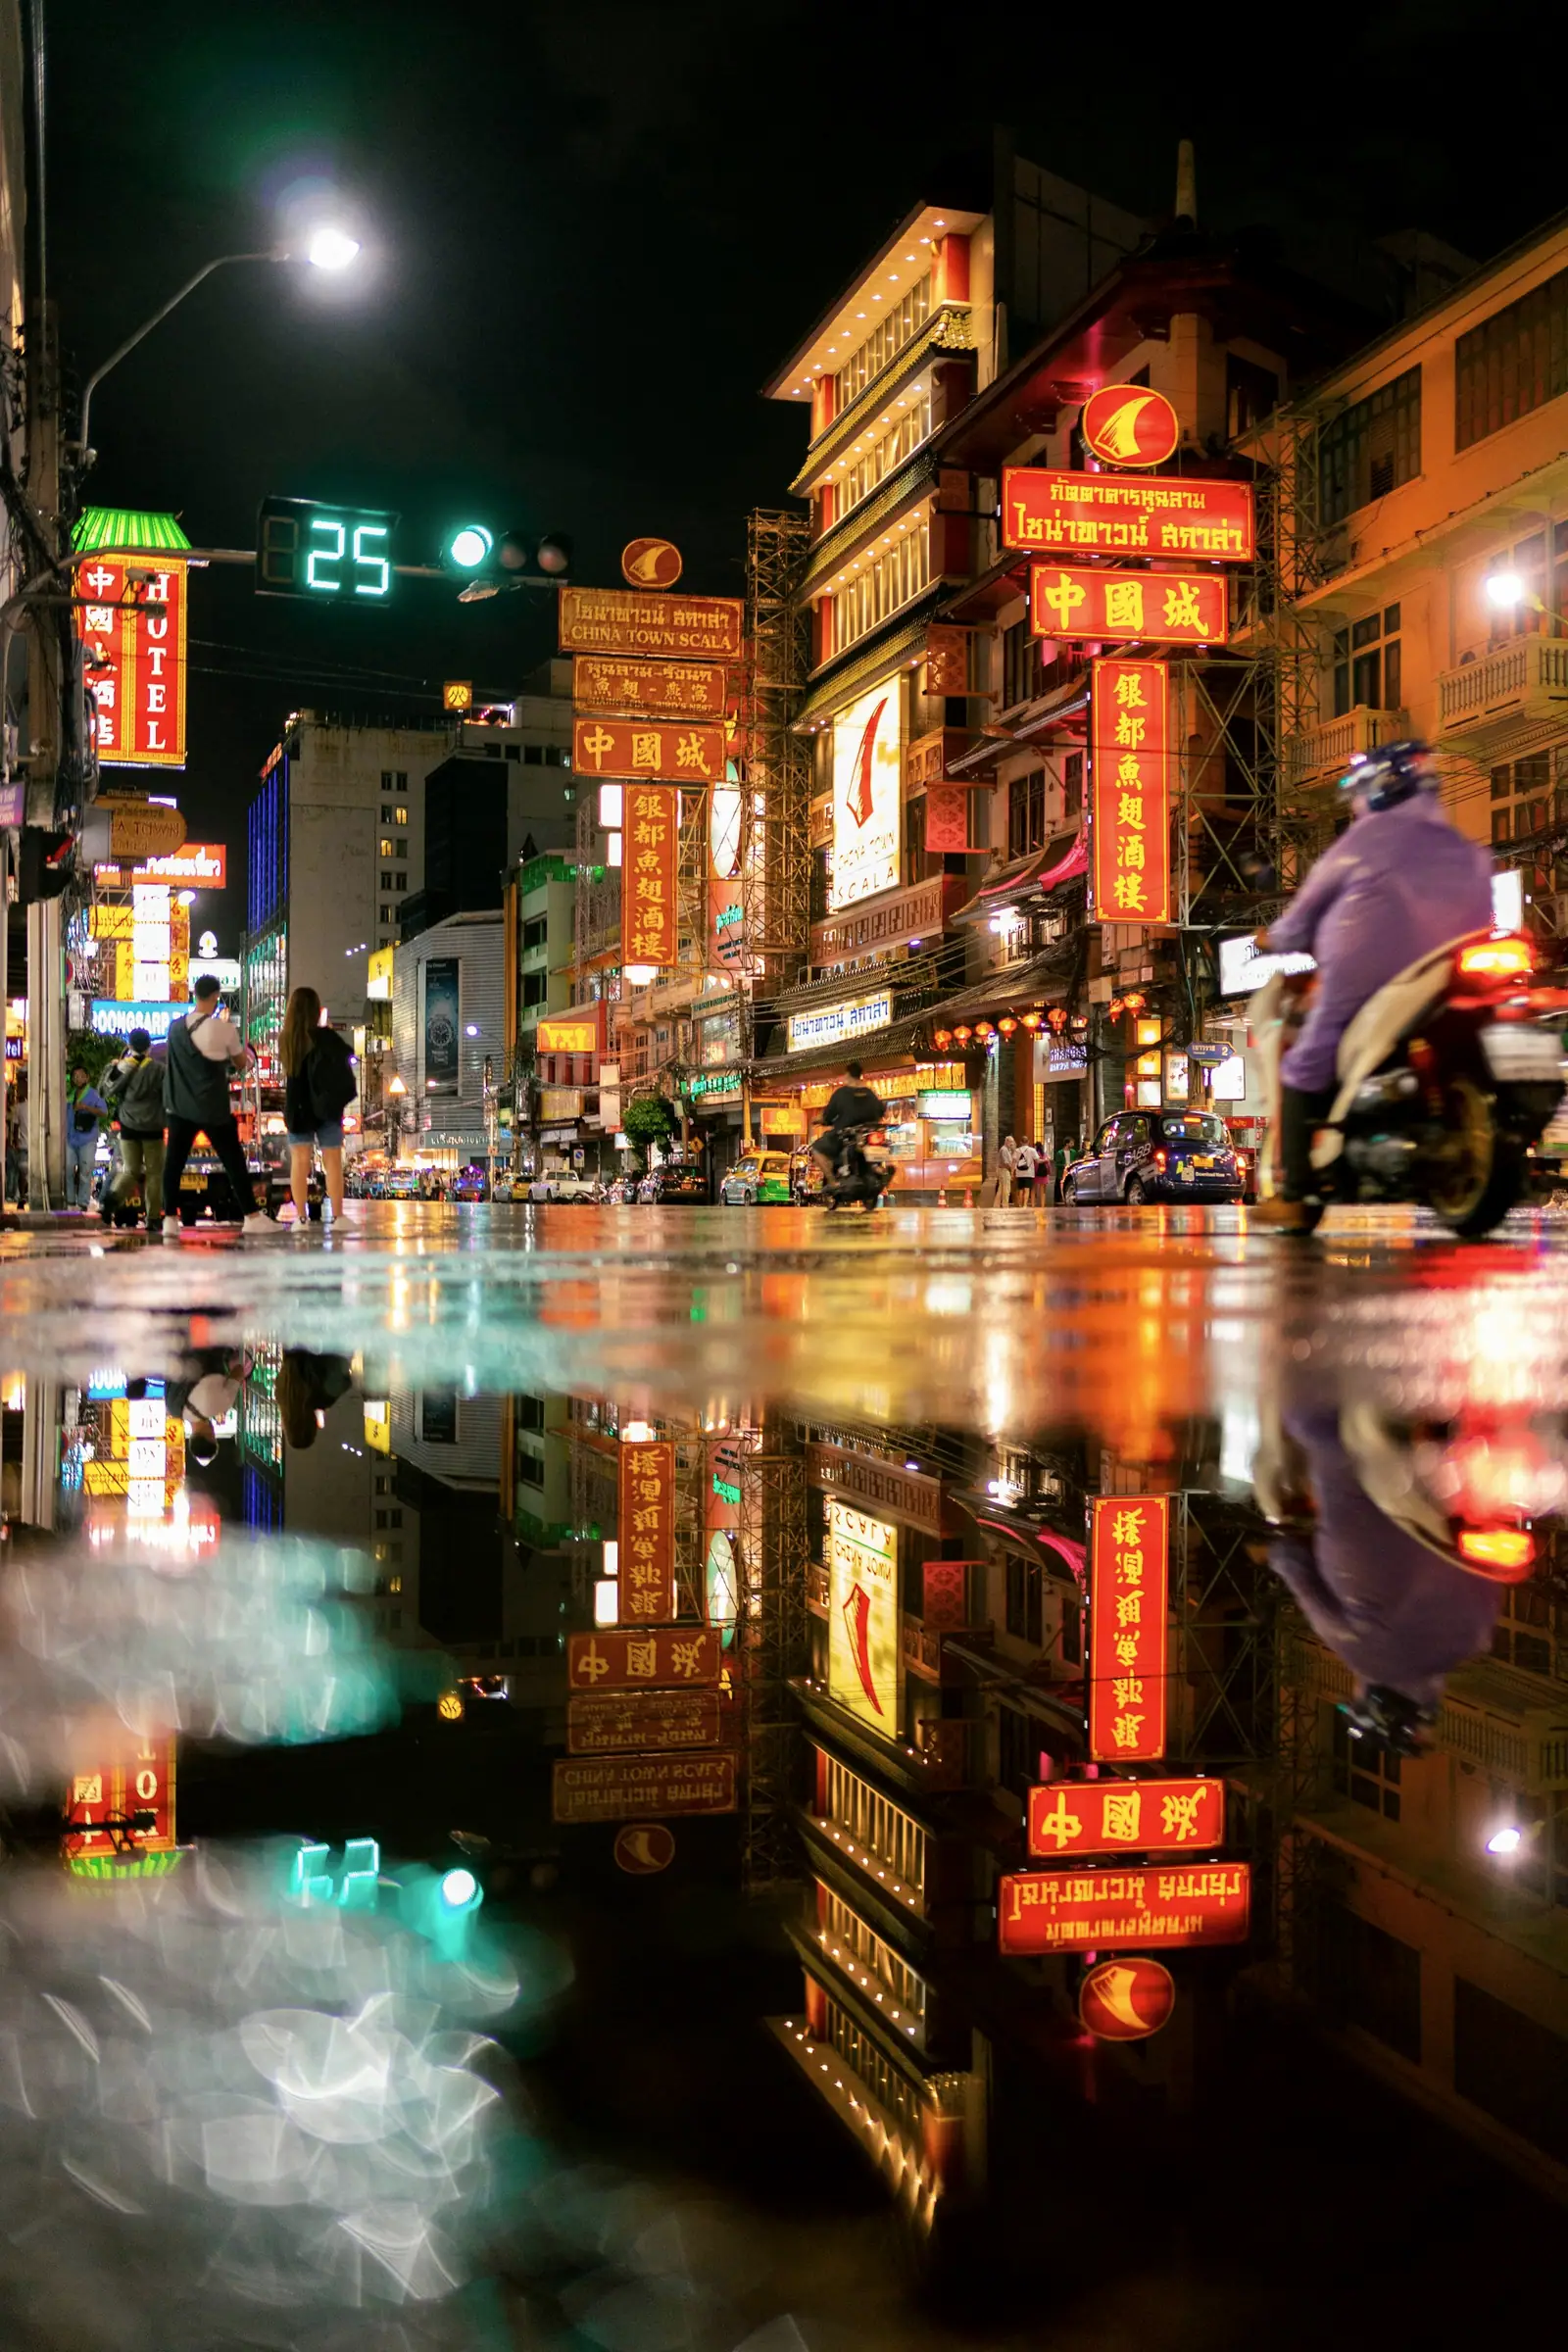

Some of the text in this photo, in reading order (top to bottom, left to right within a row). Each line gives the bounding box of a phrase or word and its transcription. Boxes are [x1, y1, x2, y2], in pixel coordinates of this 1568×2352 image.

[1050, 476, 1206, 514] ภัตตาคารหูฉลาม
[1012, 502, 1244, 552] ไชน่าทาวน์ สกาล่า
[307, 520, 390, 595] 25
[1044, 572, 1210, 637] 中國城
[146, 572, 171, 751] HOTEL
[570, 624, 733, 650] CHINA TOWN SCALA
[583, 724, 711, 777] 中國城
[631, 794, 668, 960] 銀都魚翅酒樓
[838, 866, 895, 904] SCALA
[1221, 1046, 1229, 1056] 2
